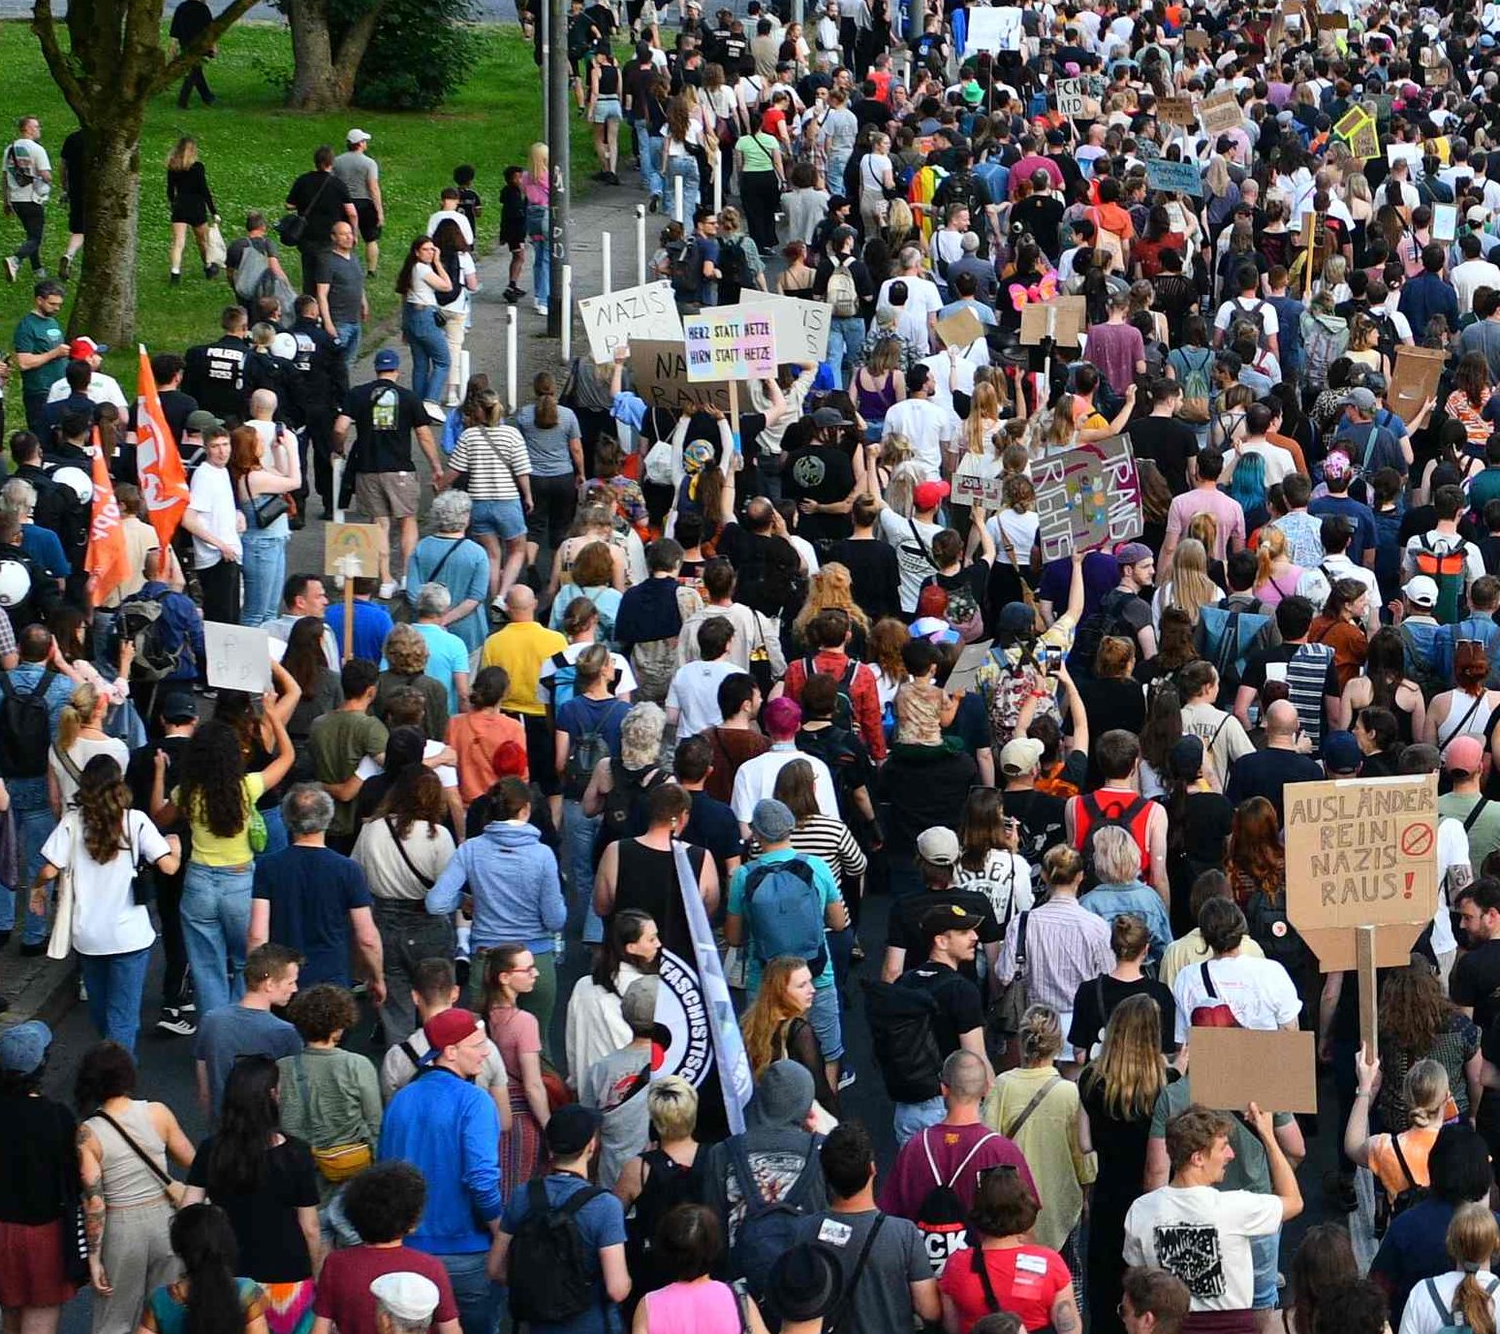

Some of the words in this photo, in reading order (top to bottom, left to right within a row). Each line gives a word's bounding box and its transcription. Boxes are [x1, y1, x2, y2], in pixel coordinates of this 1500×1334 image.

[1056, 80, 1080, 96] FCK
[1061, 98, 1082, 113] AFD
[595, 291, 667, 328] NAZIS
[688, 325, 711, 341] HERZ
[713, 323, 740, 339] STATT
[743, 319, 771, 336] HETZE
[690, 350, 712, 366] HIRN
[715, 348, 740, 364] STATT
[743, 346, 772, 361] HETZE
[1103, 434, 1142, 541] TRANS
[1038, 456, 1075, 563] RIGHTS
[1289, 786, 1435, 825] AUSLÄNDER
[1319, 820, 1389, 851] REIN
[1310, 846, 1397, 878] NAZIS
[920, 1229, 968, 1259] CK
